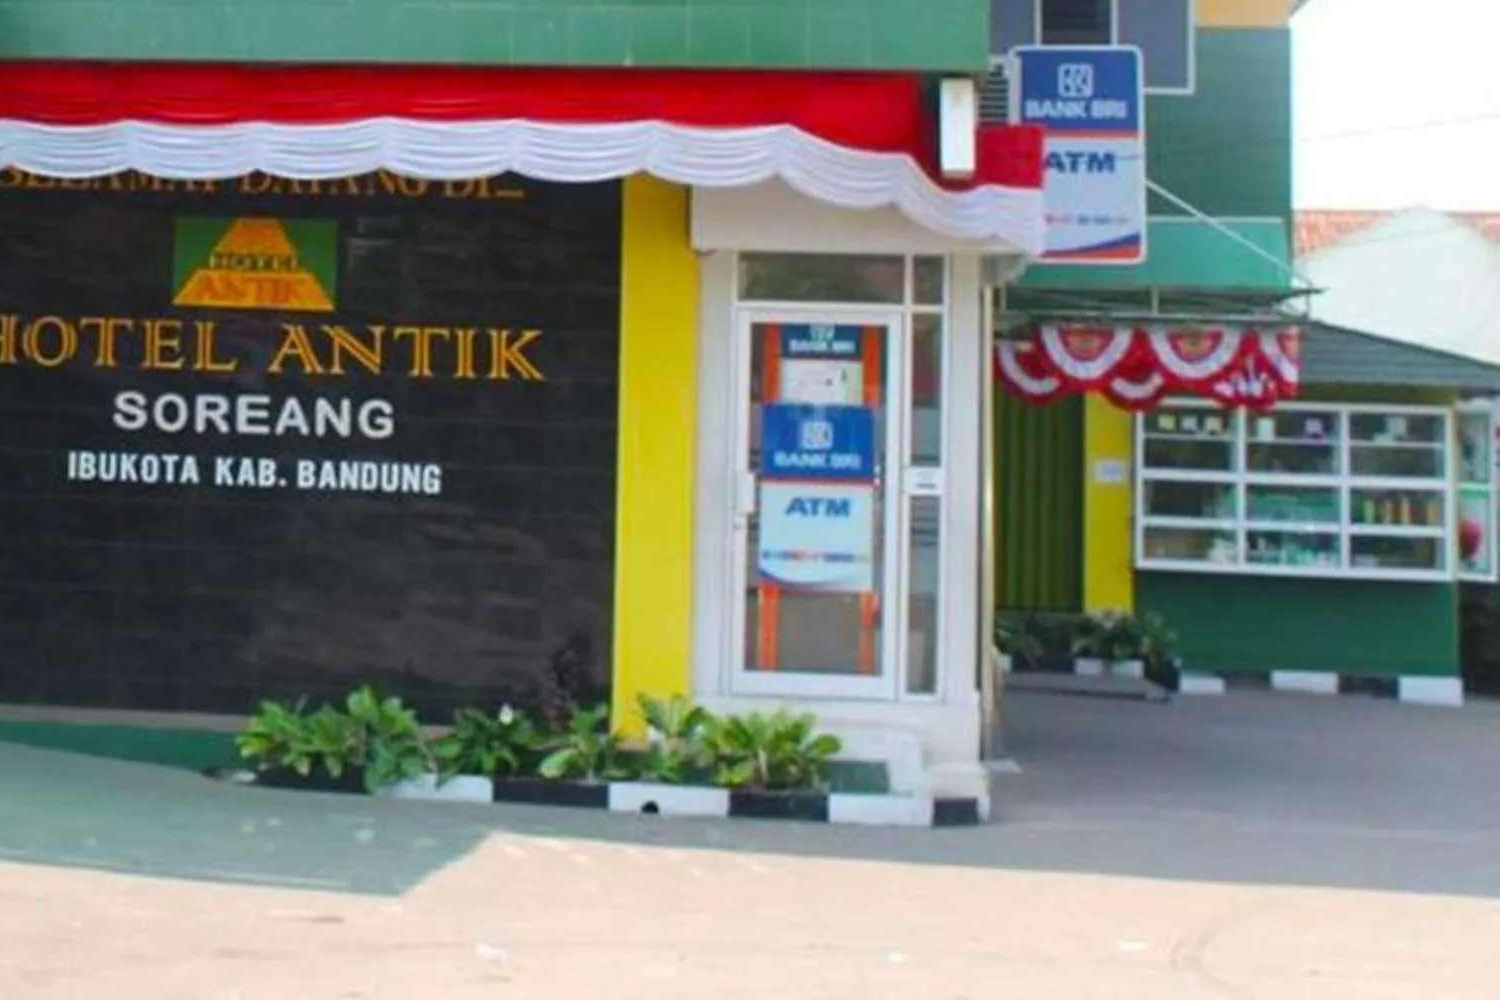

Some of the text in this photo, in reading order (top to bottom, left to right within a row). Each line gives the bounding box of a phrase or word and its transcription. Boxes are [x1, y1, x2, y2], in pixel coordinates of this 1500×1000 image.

[1025, 99, 1127, 118] BANK BRI
[1043, 151, 1117, 174] ATM
[268, 323, 546, 381] ANTIK
[112, 391, 395, 439] SOREANG
[773, 450, 862, 470] BANK BRI
[67, 450, 441, 494] IBUKOTA KAB. BANDUNG
[784, 497, 851, 517] ATM
